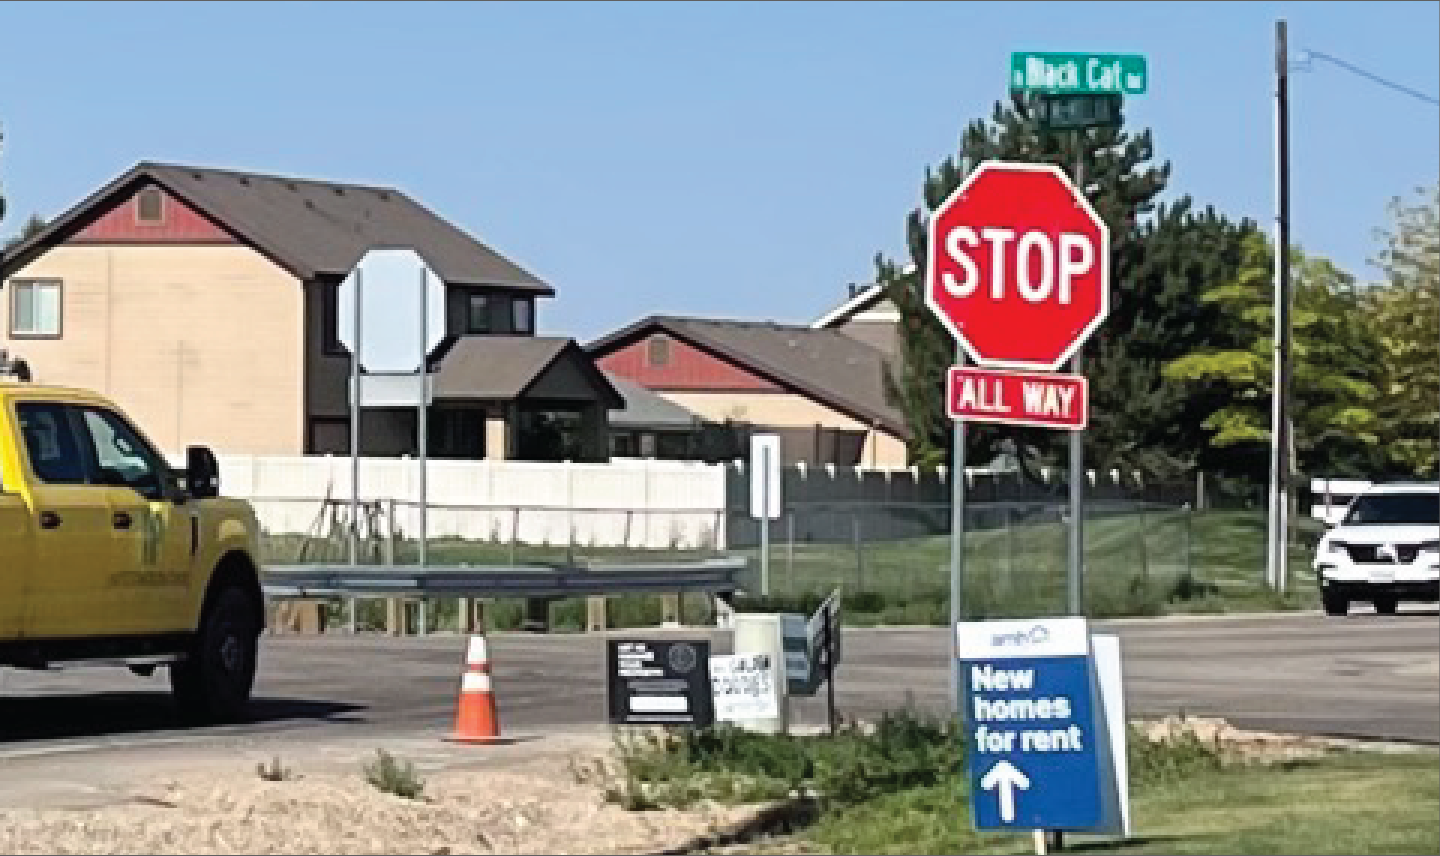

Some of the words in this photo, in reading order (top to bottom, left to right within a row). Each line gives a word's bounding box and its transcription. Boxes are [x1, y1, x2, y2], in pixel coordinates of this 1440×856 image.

[1025, 55, 1079, 89] Black
[1085, 57, 1122, 90] Cat
[941, 226, 1095, 305] STOP
[956, 376, 1012, 414] ALL
[1021, 380, 1076, 418] WAY
[971, 664, 1035, 692] New
[974, 696, 1072, 720] homes
[974, 724, 1017, 752] for
[1020, 725, 1083, 752] rent
